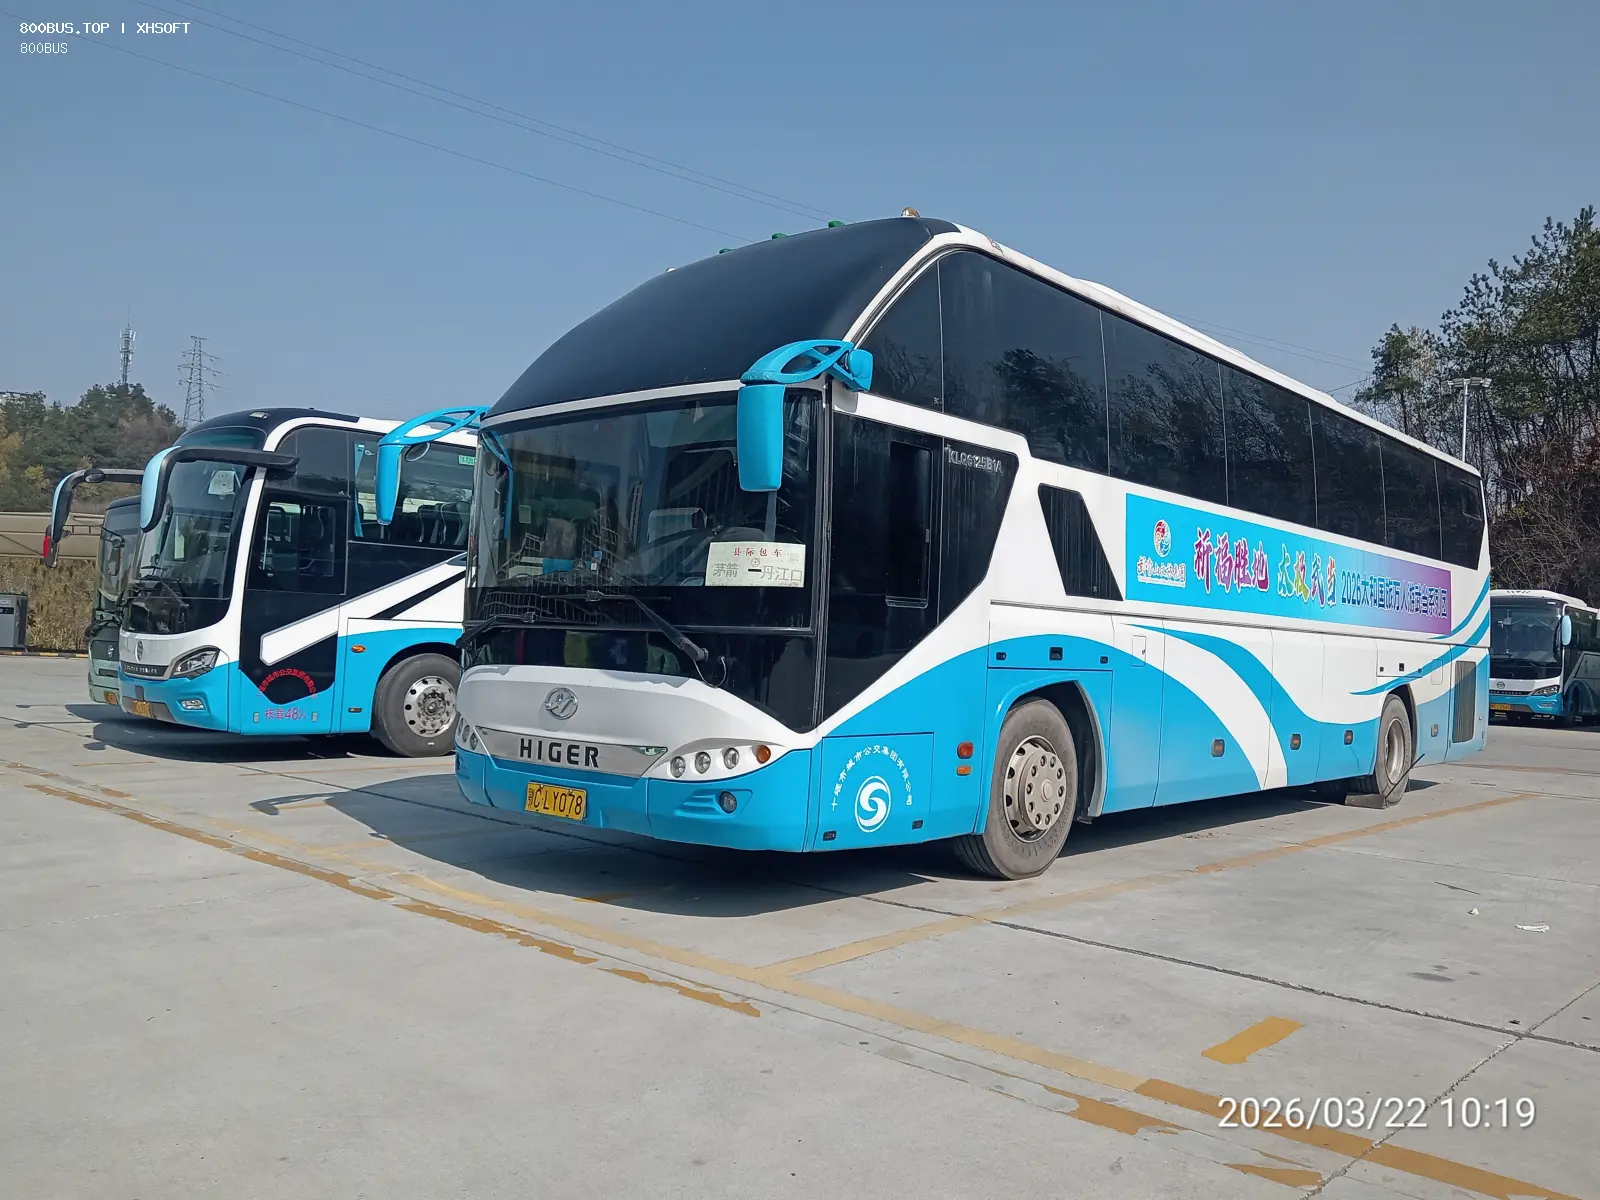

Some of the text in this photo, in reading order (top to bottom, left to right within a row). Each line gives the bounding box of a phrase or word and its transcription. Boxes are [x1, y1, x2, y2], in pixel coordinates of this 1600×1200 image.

[733, 547, 782, 558] 县际包车
[1193, 527, 1270, 594] 祈福胜地
[713, 562, 740, 578] 茅箭
[761, 565, 803, 583] 丹江口
[1277, 543, 1337, 607] 太极武当
[265, 707, 307, 720] 核载48人
[520, 738, 599, 768] HIGER
